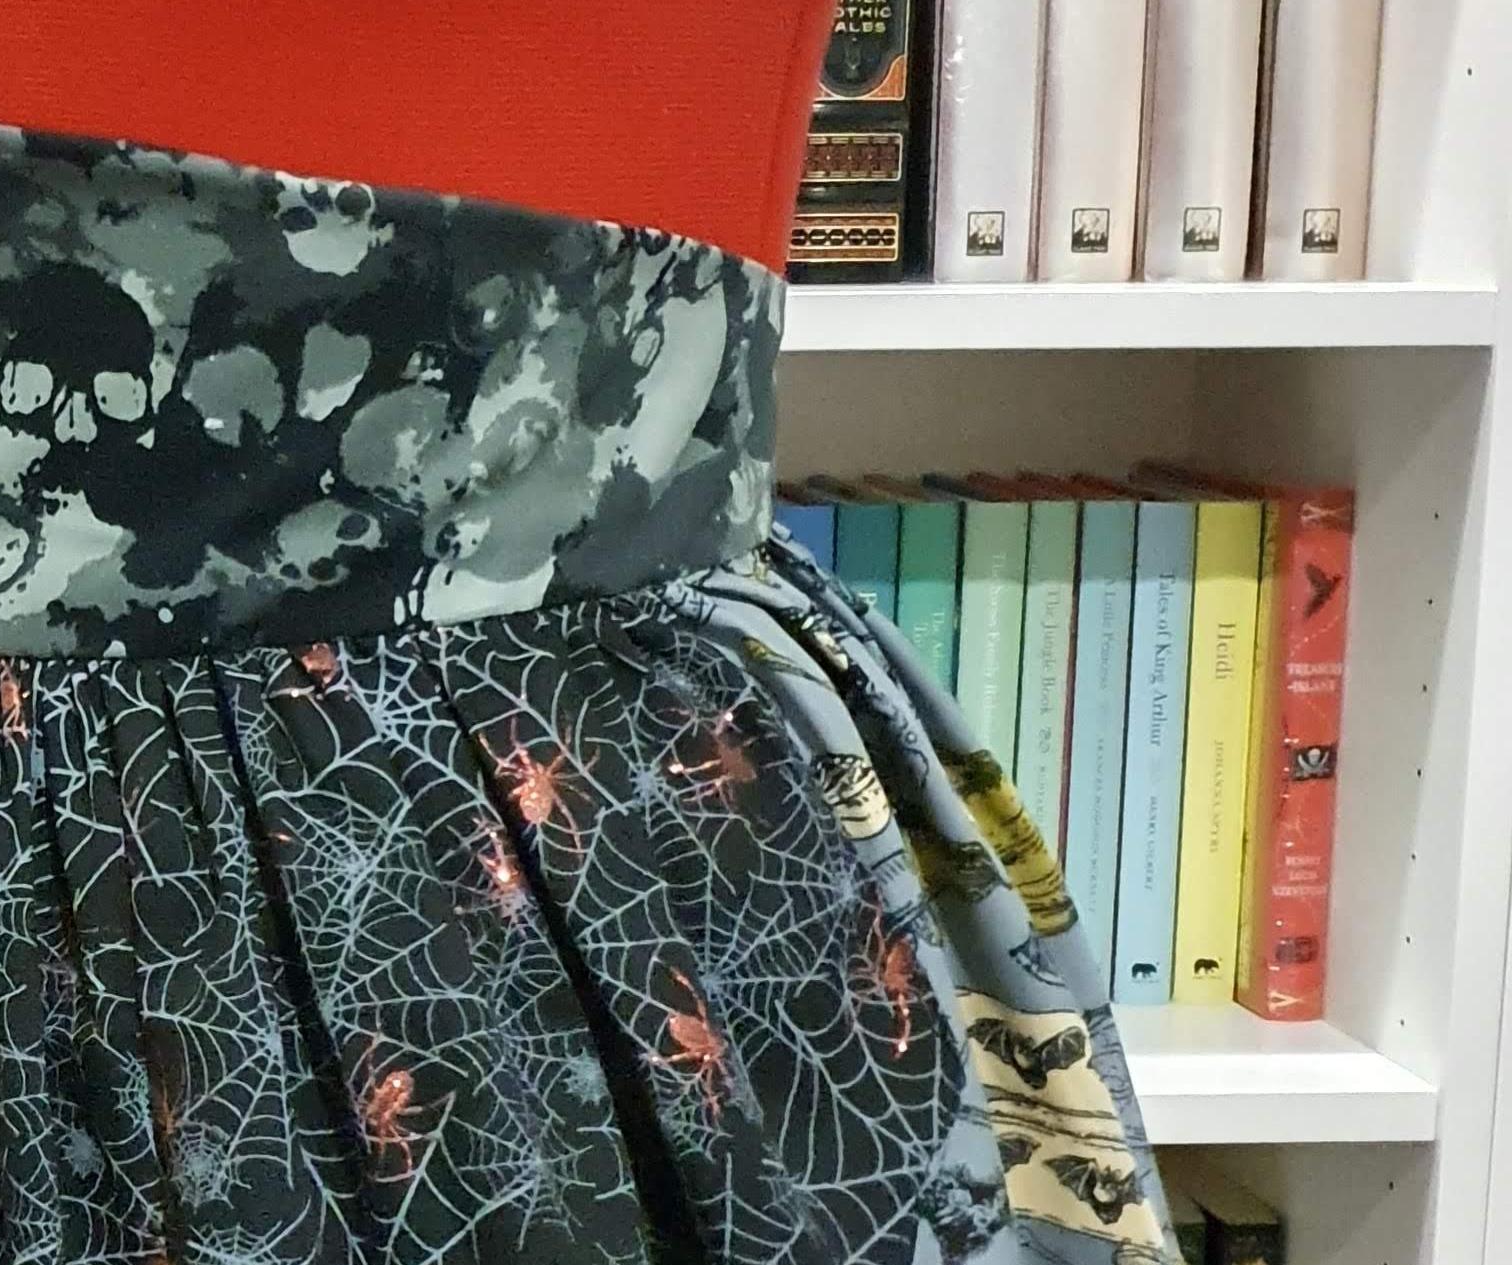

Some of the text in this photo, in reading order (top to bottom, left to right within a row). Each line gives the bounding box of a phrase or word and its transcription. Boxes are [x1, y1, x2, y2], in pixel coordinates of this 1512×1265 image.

[834, 7, 891, 18] OTHIC
[835, 21, 886, 33] ALES
[1045, 587, 1060, 617] The
[1040, 622, 1058, 673] Jungle
[1149, 573, 1176, 747] Tales of King Arthur
[1214, 622, 1237, 680] Heidi
[1040, 677, 1056, 715] Book
